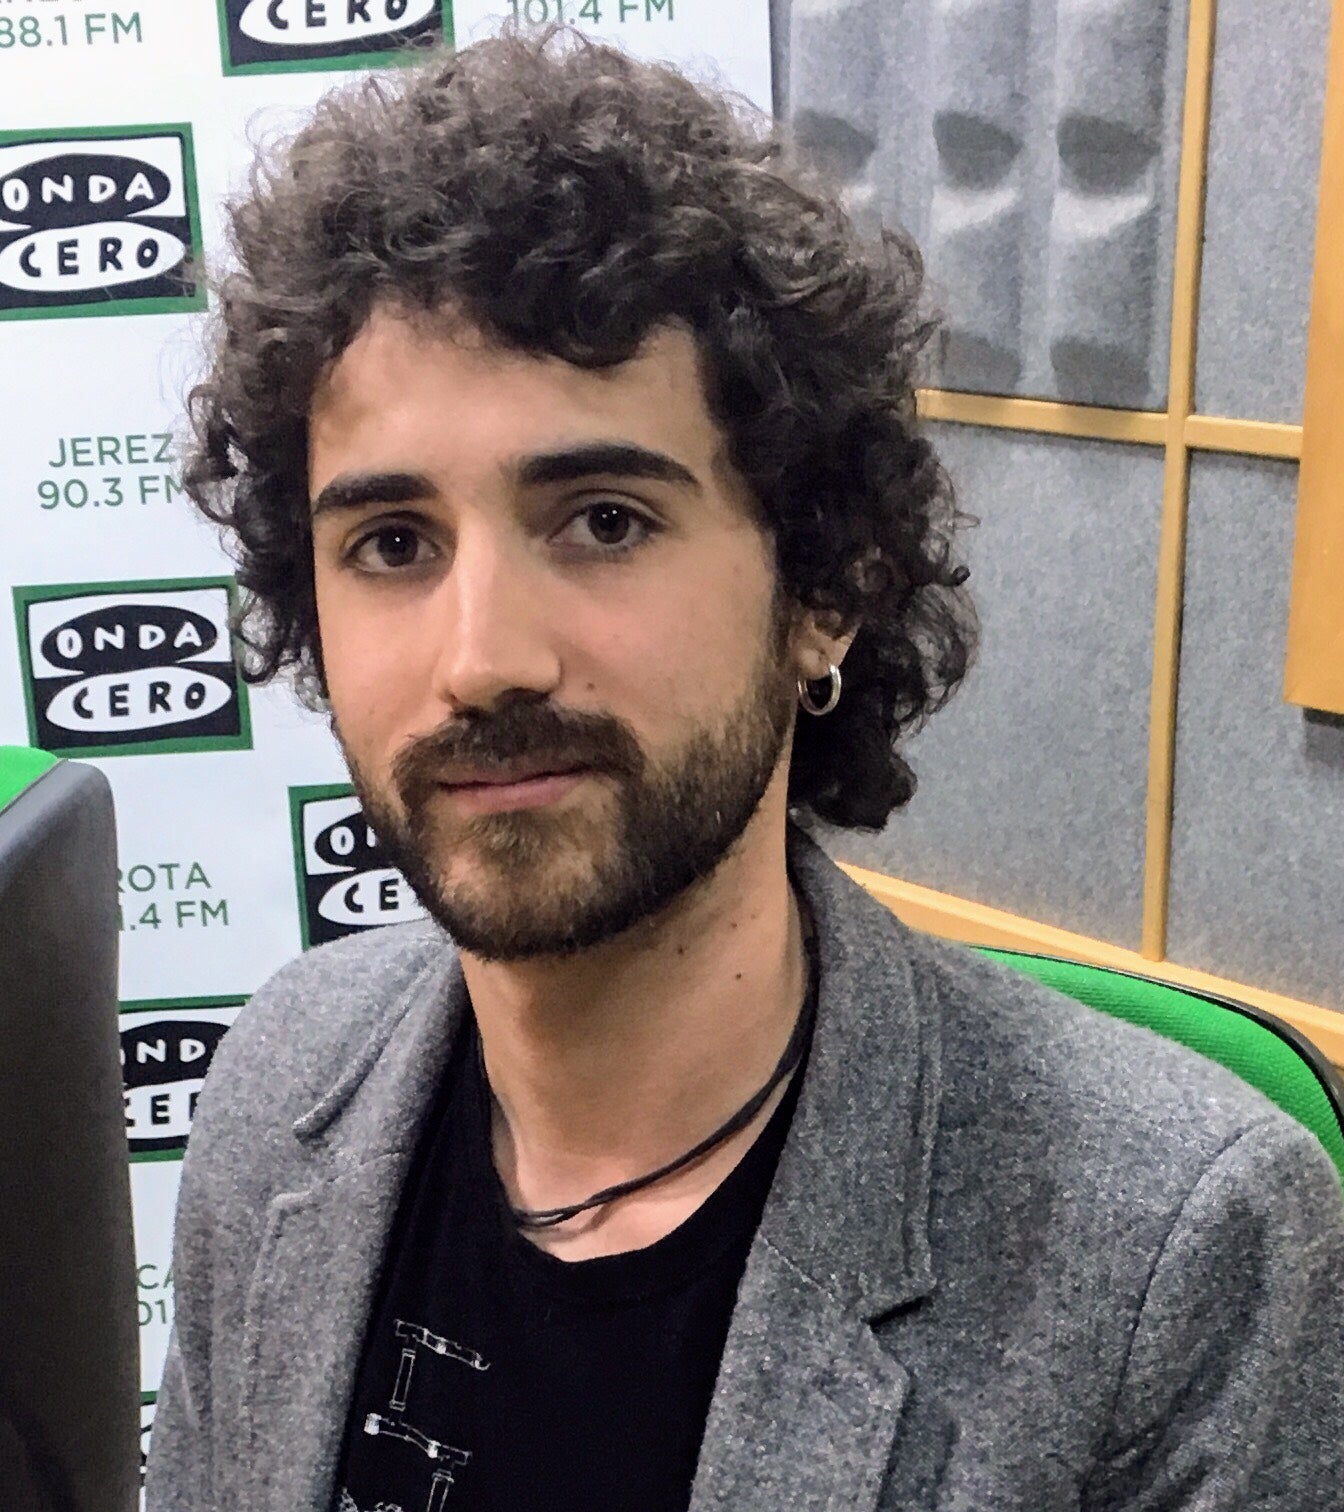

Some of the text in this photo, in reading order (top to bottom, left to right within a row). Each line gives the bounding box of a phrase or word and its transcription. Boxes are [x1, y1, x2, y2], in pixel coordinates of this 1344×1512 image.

[85, 12, 143, 45] FM
[266, 0, 409, 30] CERO
[619, 0, 675, 23] FM
[1, 171, 156, 212] ONDA
[19, 238, 158, 278] CERO
[48, 433, 176, 468] JEREZ
[37, 476, 124, 510] 90.3
[56, 622, 203, 660] ONDA
[72, 681, 209, 720] CERO
[175, 898, 229, 929] FM
[344, 878, 400, 914] CE
